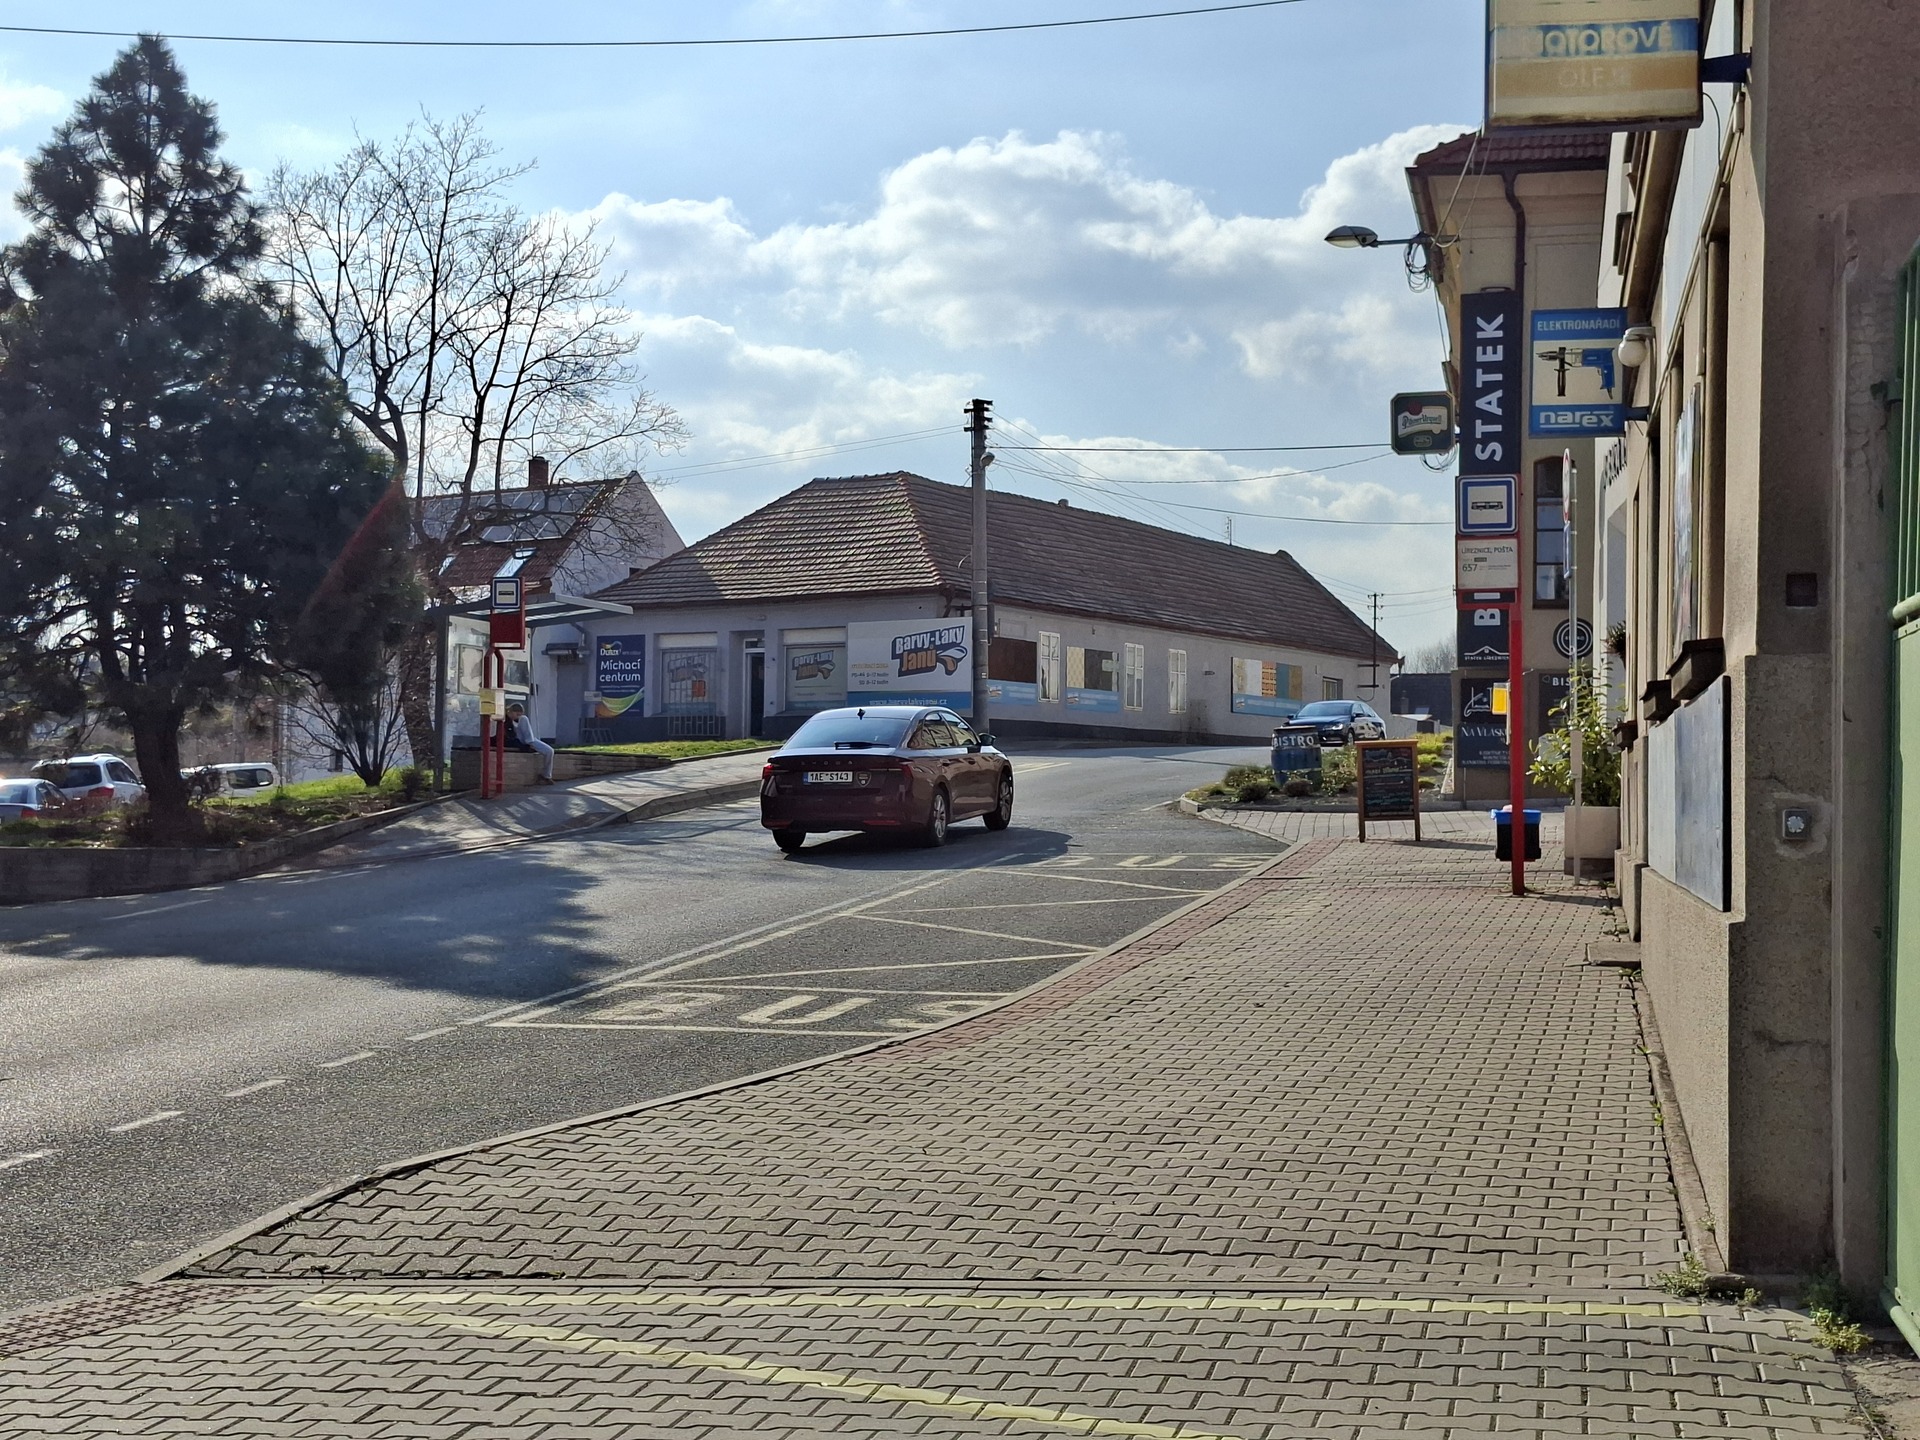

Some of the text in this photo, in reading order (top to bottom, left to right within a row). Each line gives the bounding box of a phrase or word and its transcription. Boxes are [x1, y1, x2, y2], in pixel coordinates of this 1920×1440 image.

[1475, 313, 1504, 462] STATEK
[1540, 410, 1614, 428] narex
[1462, 563, 1478, 572] 657
[600, 648, 620, 656] Dulux
[600, 658, 641, 671] Míchací
[599, 671, 641, 682] centrum
[1273, 735, 1315, 749] BISTRO
